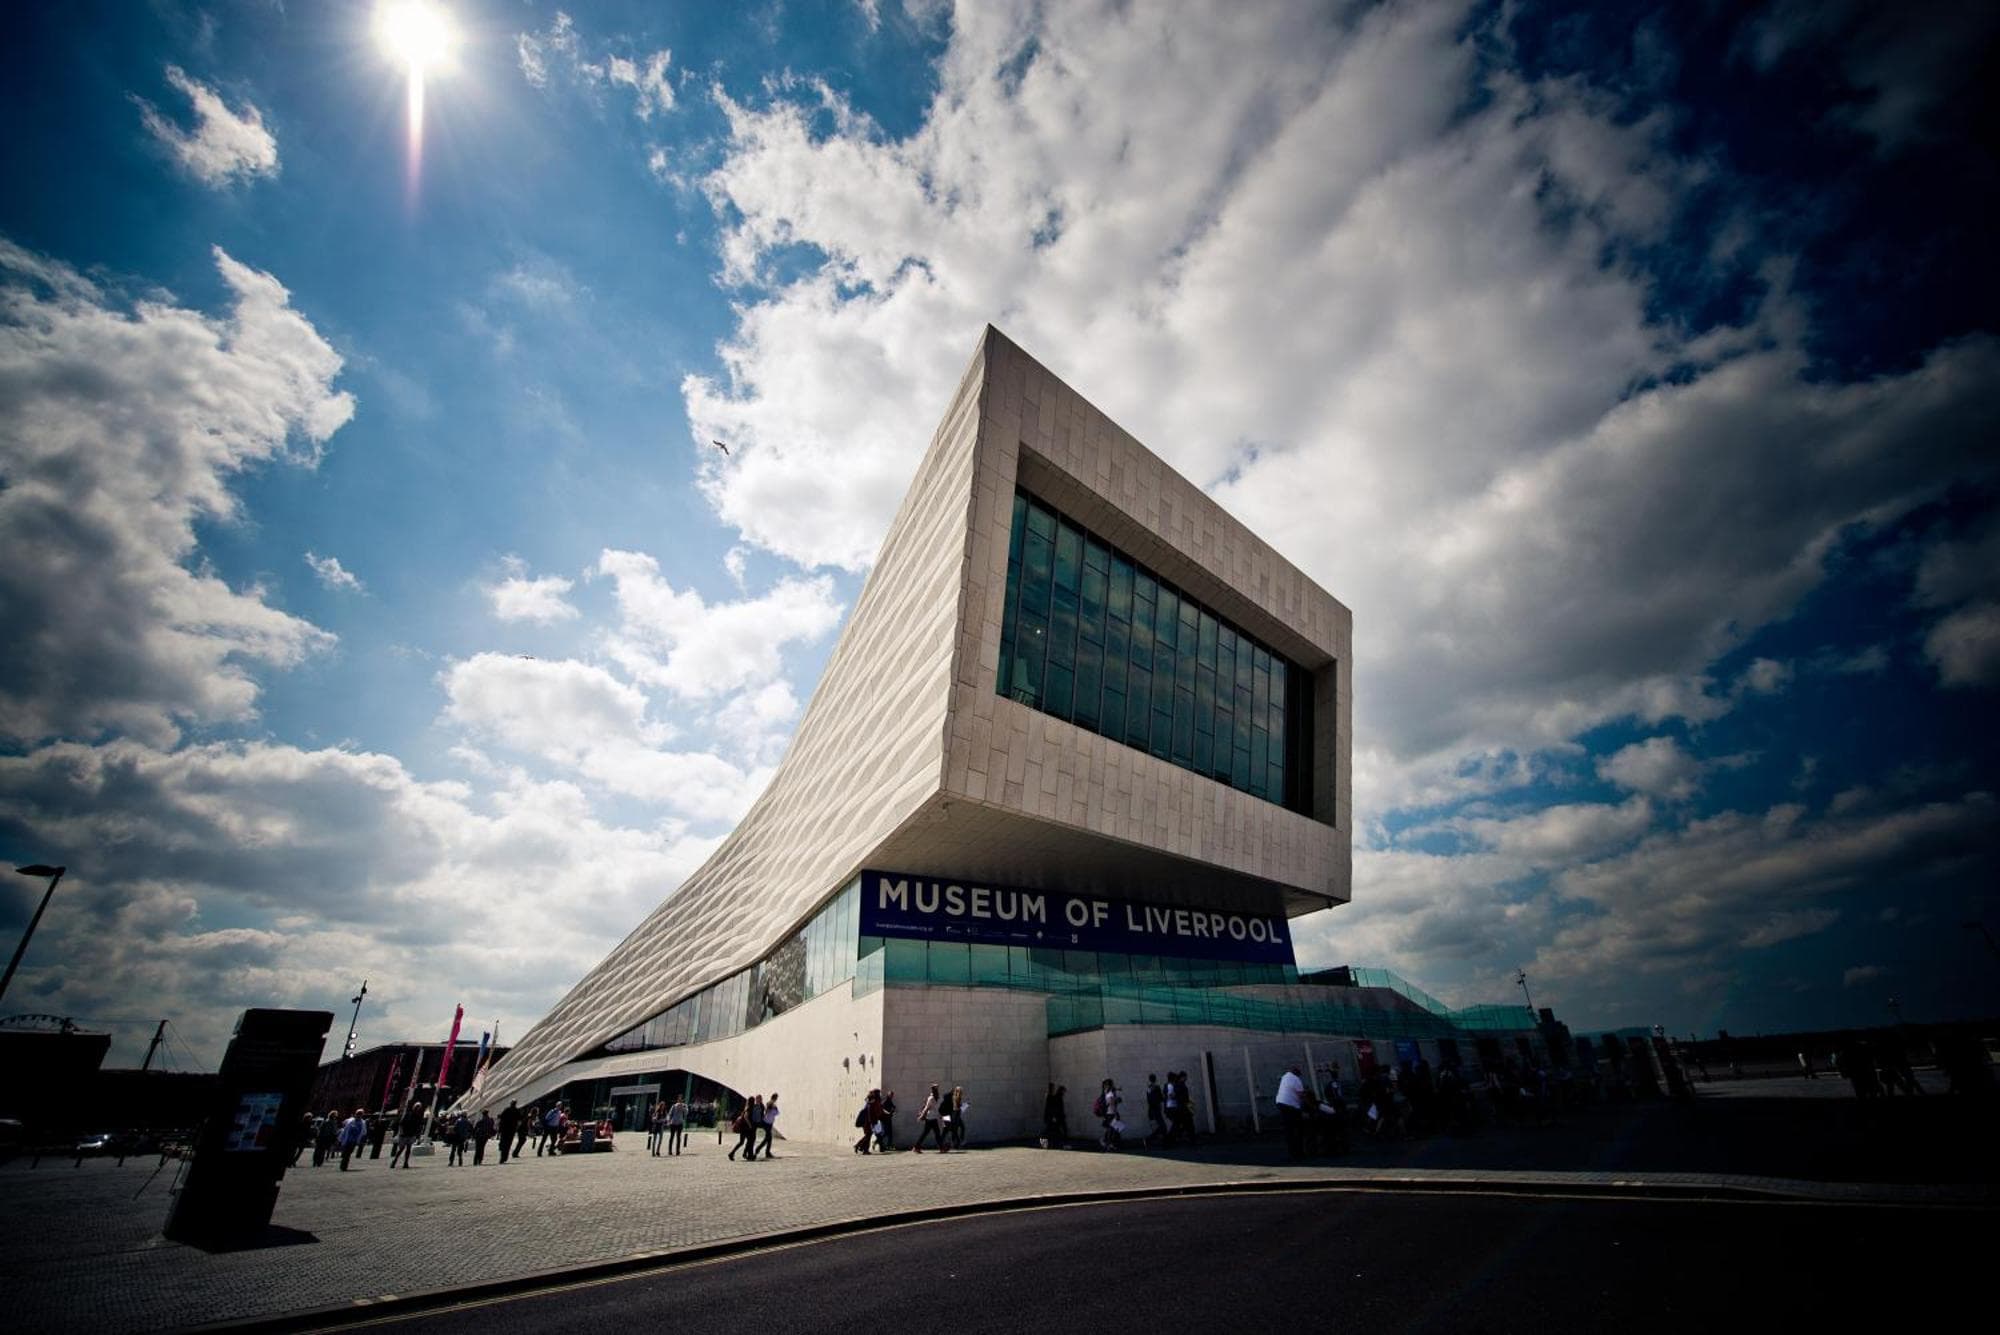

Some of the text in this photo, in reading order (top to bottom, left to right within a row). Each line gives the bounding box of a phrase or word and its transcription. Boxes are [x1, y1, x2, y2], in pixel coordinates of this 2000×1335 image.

[879, 878, 1283, 944] MUSEUM OF LIVERPOOL
